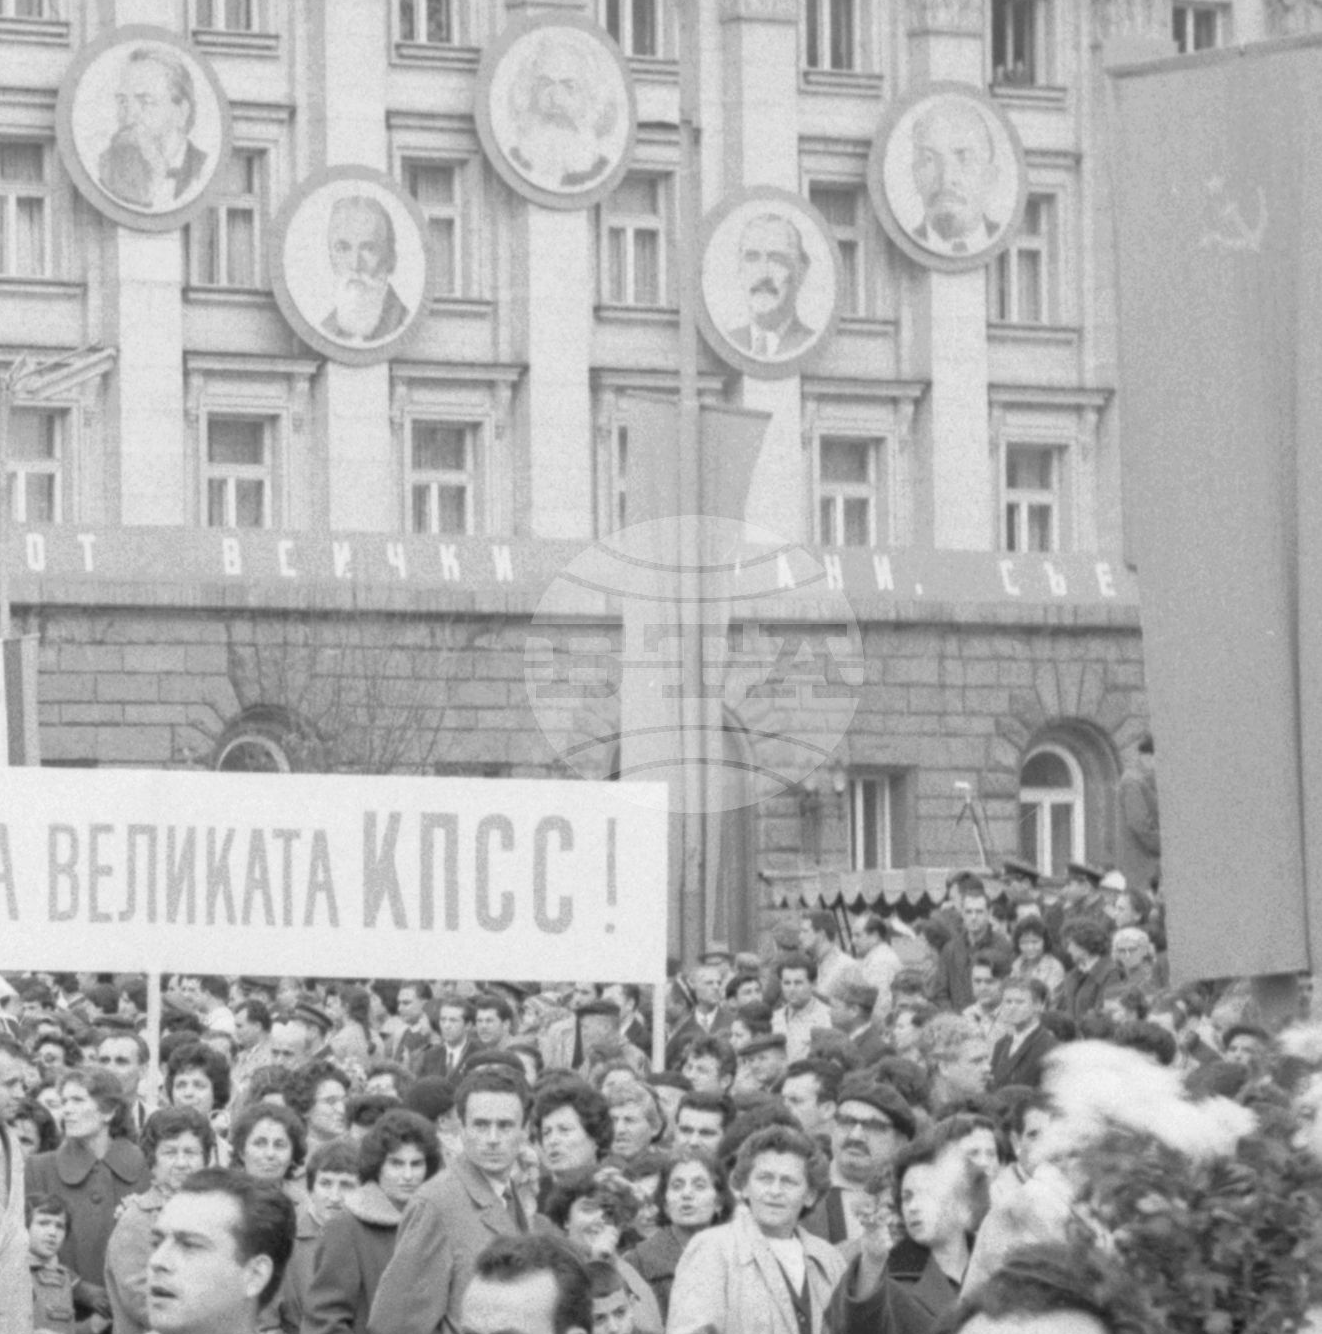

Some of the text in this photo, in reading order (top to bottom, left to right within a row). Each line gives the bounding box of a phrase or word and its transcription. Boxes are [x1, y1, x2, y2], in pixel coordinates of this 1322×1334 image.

[25, 532, 97, 573] ОТ
[221, 537, 514, 582] ВСИЧКИ
[47, 822, 341, 929] ВЕЛИКАТА
